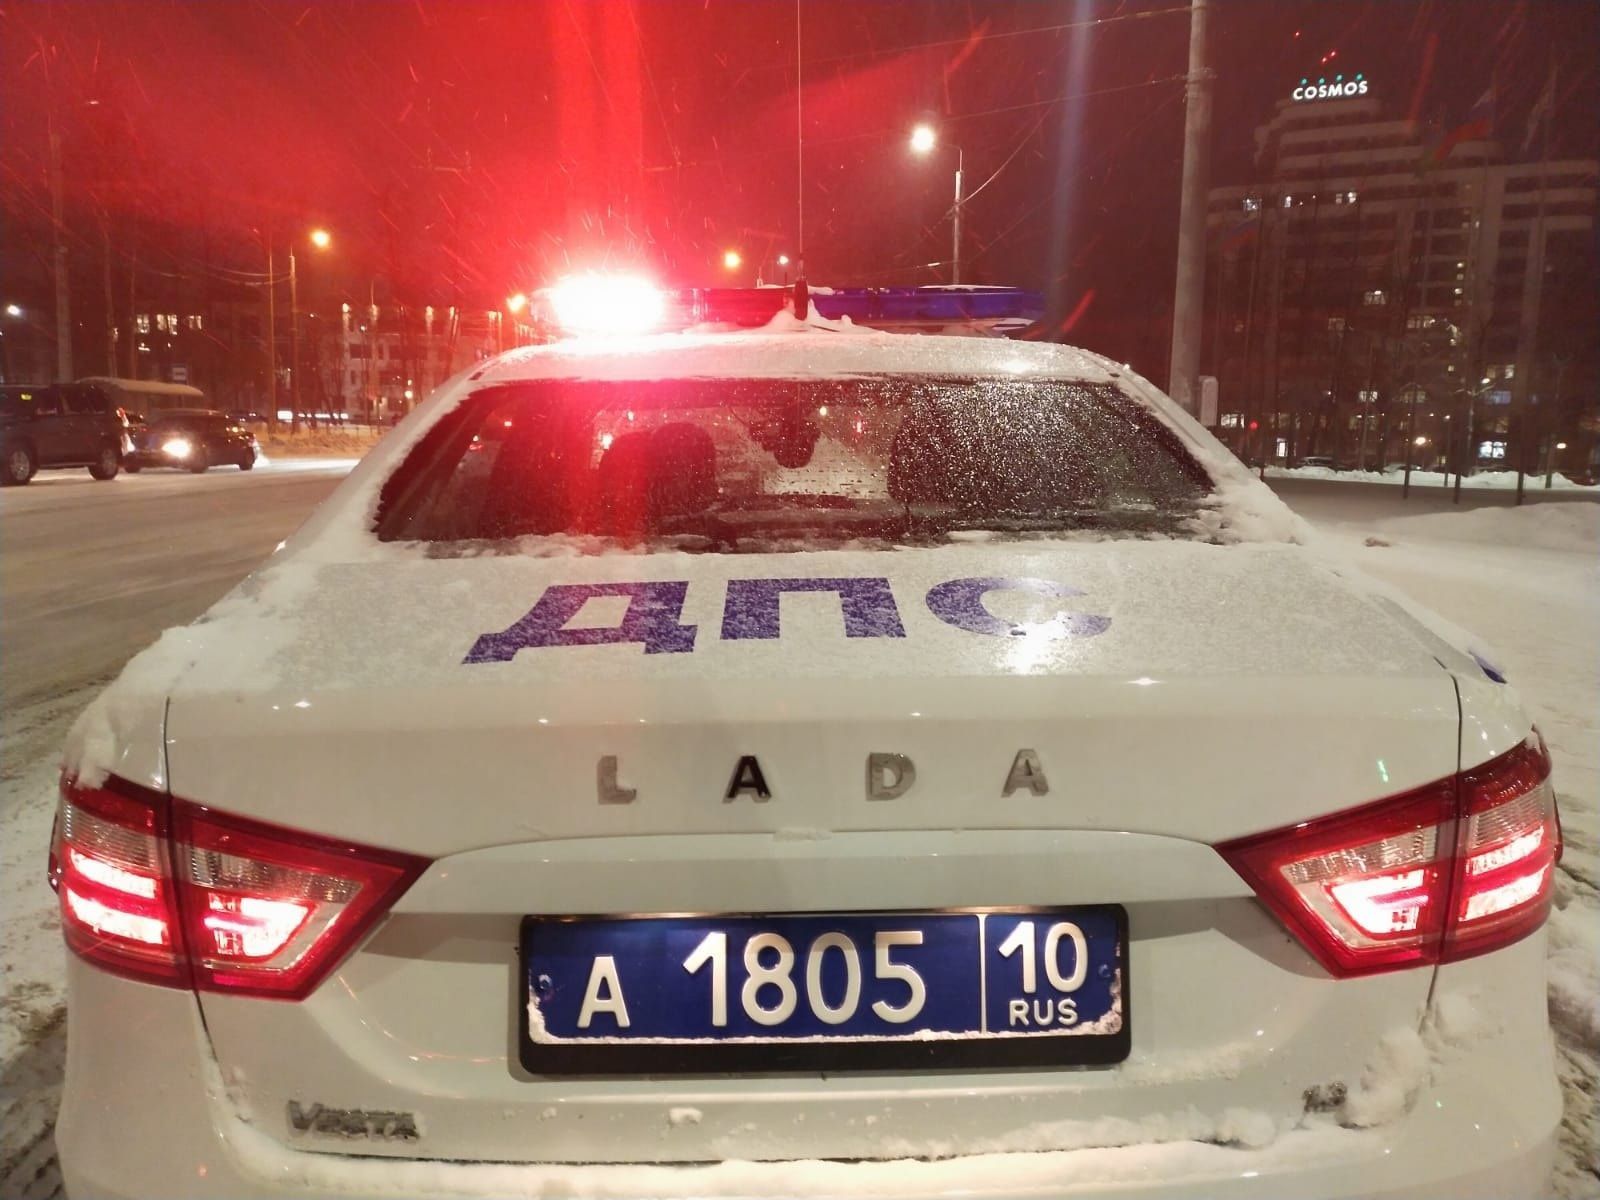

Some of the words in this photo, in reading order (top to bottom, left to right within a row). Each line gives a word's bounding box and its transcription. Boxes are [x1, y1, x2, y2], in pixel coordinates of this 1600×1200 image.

[1292, 80, 1368, 101] COSMOS
[461, 577, 1112, 664] ДПС
[596, 748, 1050, 804] LADA
[682, 931, 927, 1027] 1805
[998, 921, 1088, 994] 10
[1008, 999, 1079, 1027] RUS
